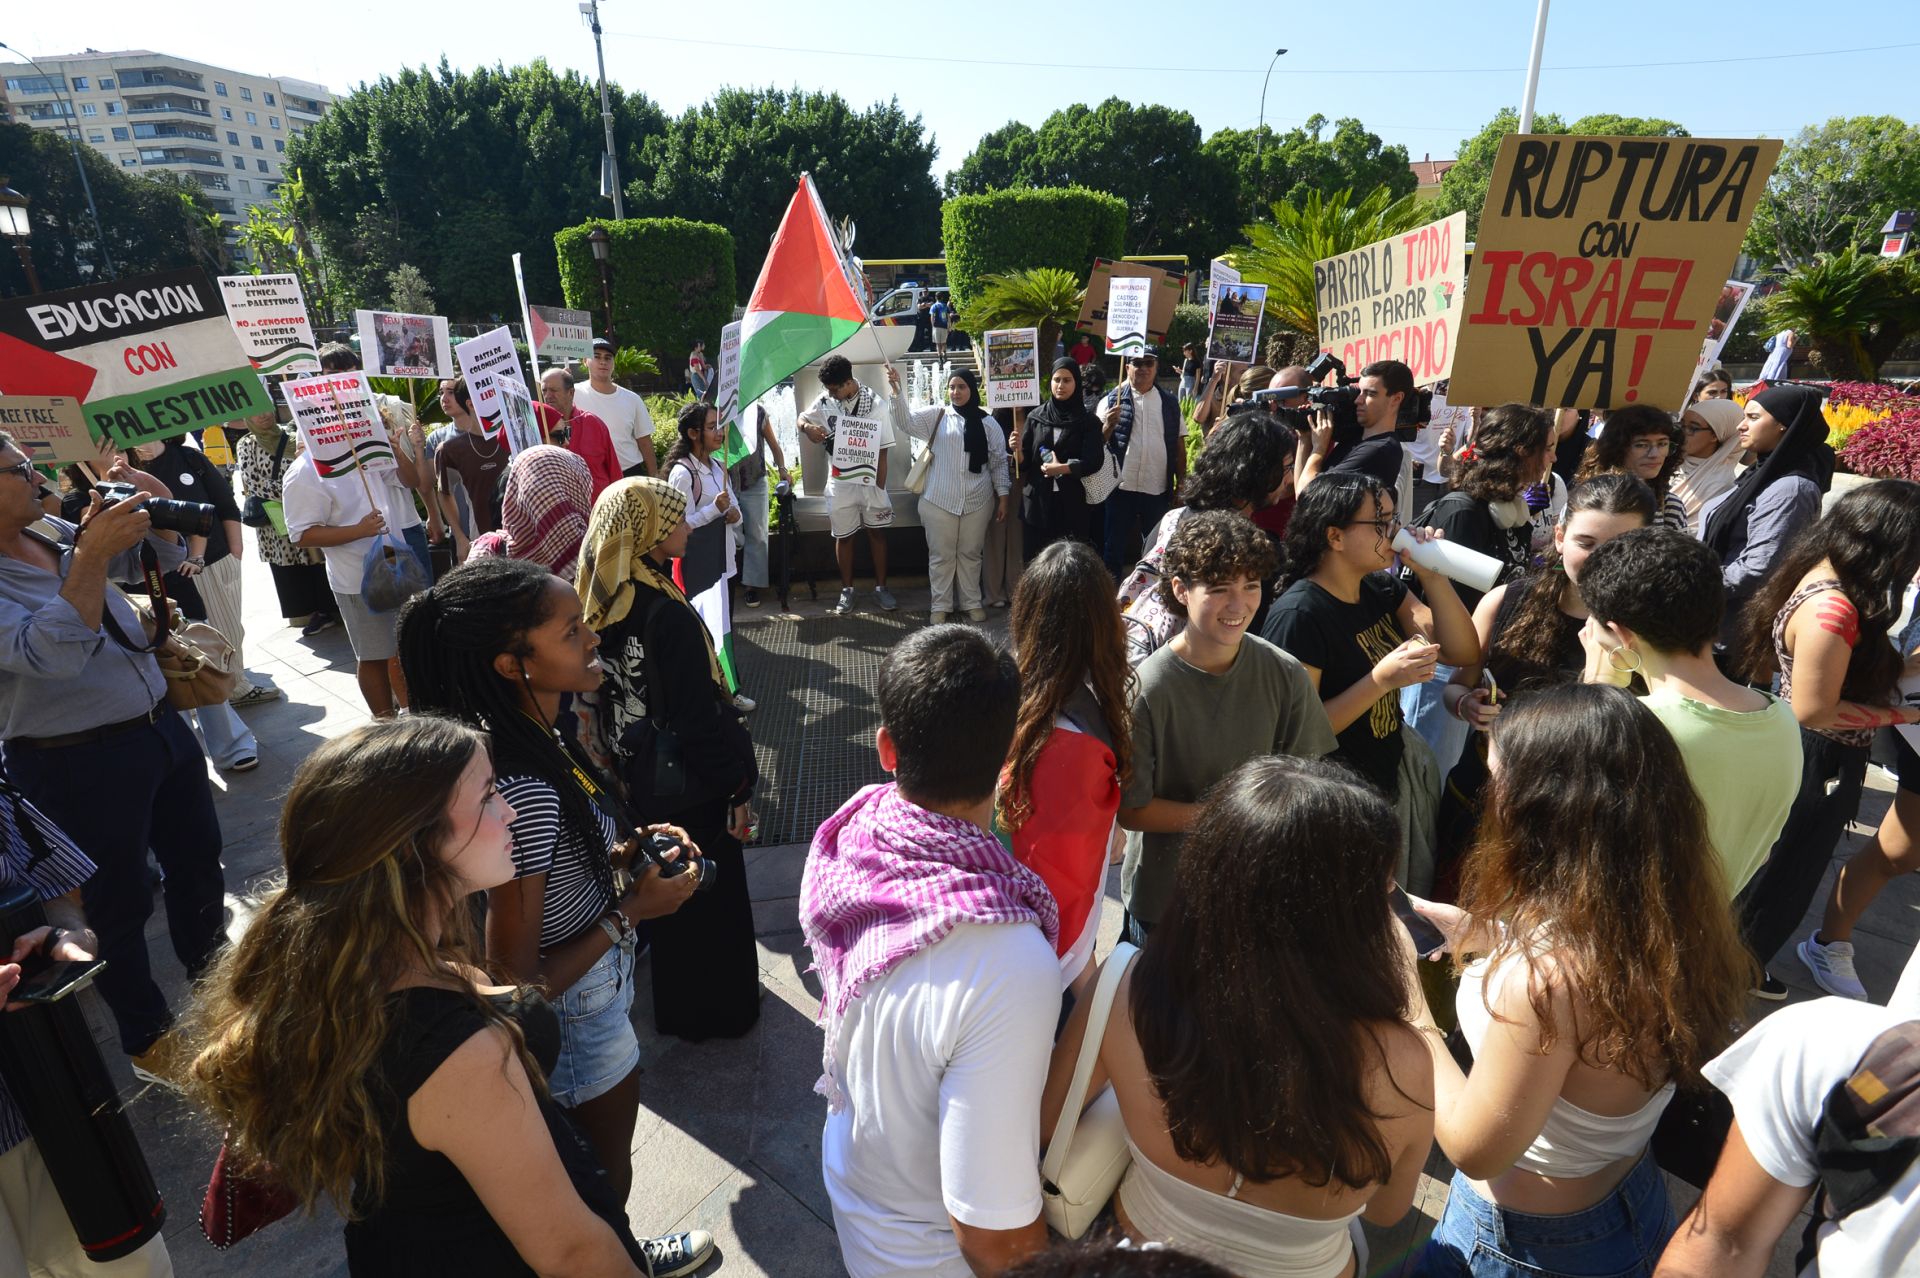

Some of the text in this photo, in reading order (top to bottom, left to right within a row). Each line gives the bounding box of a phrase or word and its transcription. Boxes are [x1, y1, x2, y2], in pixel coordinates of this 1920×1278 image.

[1501, 140, 1760, 222] RUPTURA
[1578, 221, 1641, 258] CON
[1315, 221, 1450, 312] PARARLO TODO
[245, 288, 278, 297] ÉTNICA
[250, 278, 294, 287] LIMPIEZA
[1469, 251, 1697, 330] ISRAEL
[26, 284, 204, 340] EDUCACION
[246, 297, 299, 307] PALESTINOS
[236, 320, 249, 328] NO
[257, 316, 305, 327] GENOCIDIO
[1320, 287, 1427, 343] PARA PARAR
[253, 336, 300, 347] PALESTINO
[262, 327, 297, 336] PUEBLO
[124, 341, 178, 376] CON
[470, 351, 512, 375] COLONIALISMO
[474, 346, 501, 363] BASTA DE
[1527, 327, 1653, 409] YA!
[293, 378, 360, 398] LIBERTAD
[24, 408, 59, 424] FREE
[93, 380, 253, 441] PALESTINA
[841, 419, 878, 431] ROMPAMOS
[849, 429, 869, 438] ASEDIO
[847, 437, 867, 448] GAZA
[837, 448, 875, 459] SOLIDARIDAD
[149, 570, 162, 598] Canon
[572, 767, 596, 794] Nikon
